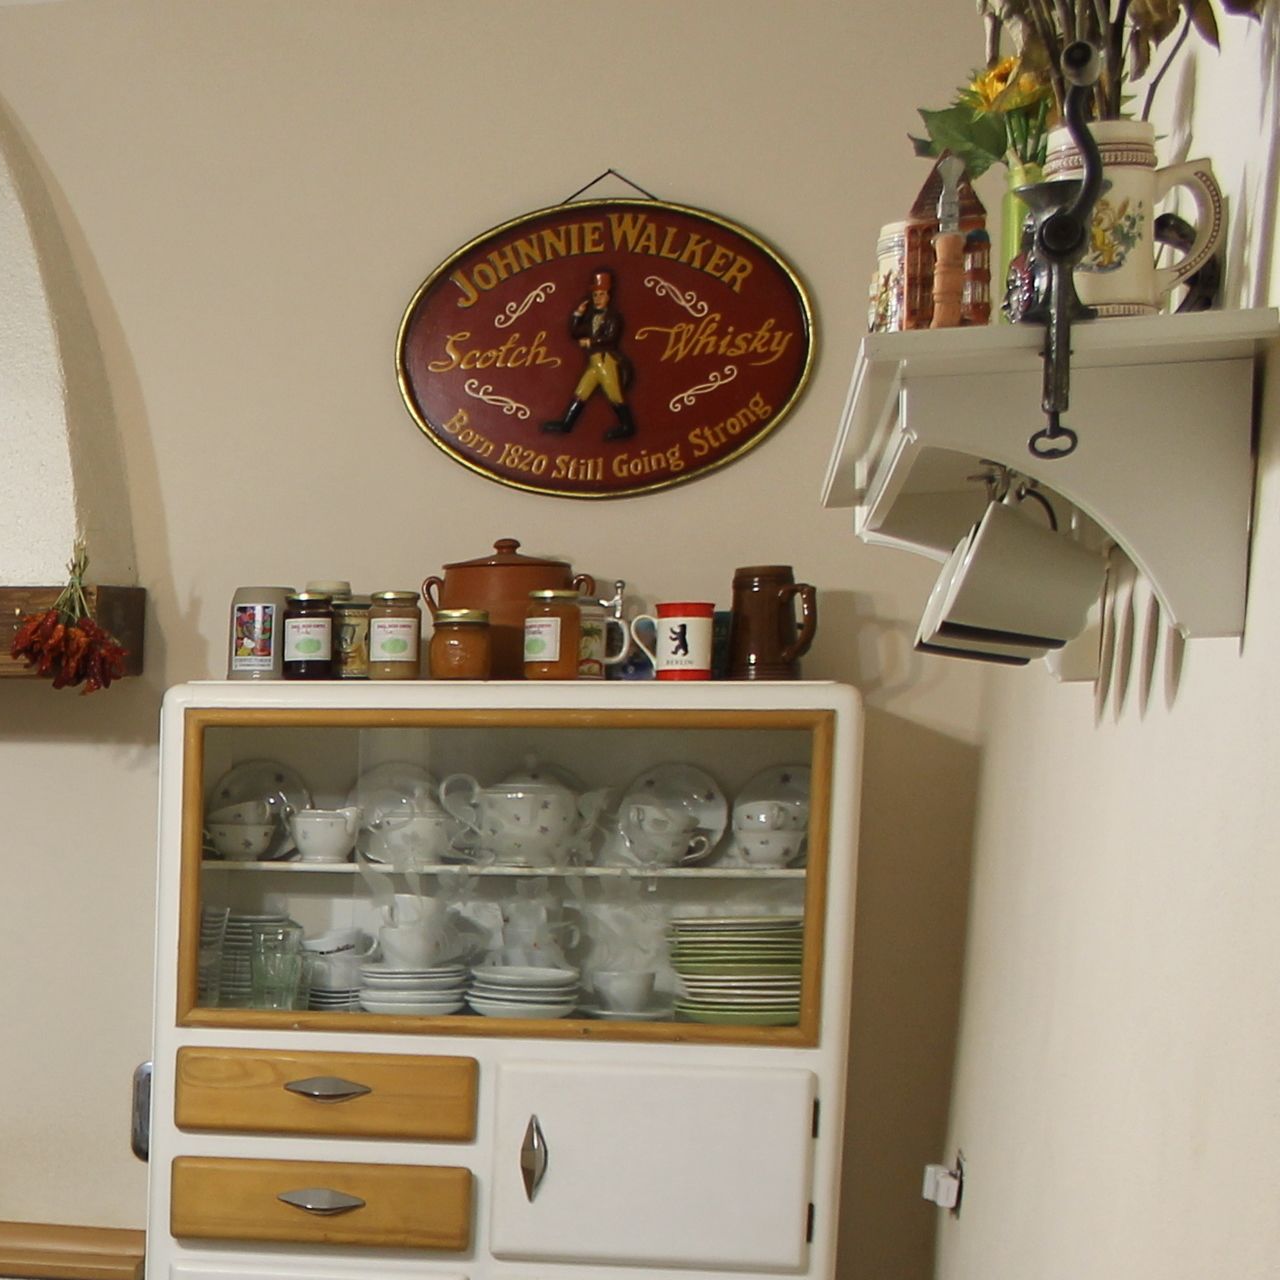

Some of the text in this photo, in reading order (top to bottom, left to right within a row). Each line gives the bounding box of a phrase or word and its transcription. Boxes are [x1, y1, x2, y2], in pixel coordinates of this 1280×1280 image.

[449, 213, 754, 308] JOHNNIE WALKER
[428, 331, 561, 372] Scotch
[635, 313, 793, 366] Whisky
[442, 393, 773, 481] Born 1820 Still Going Strong
